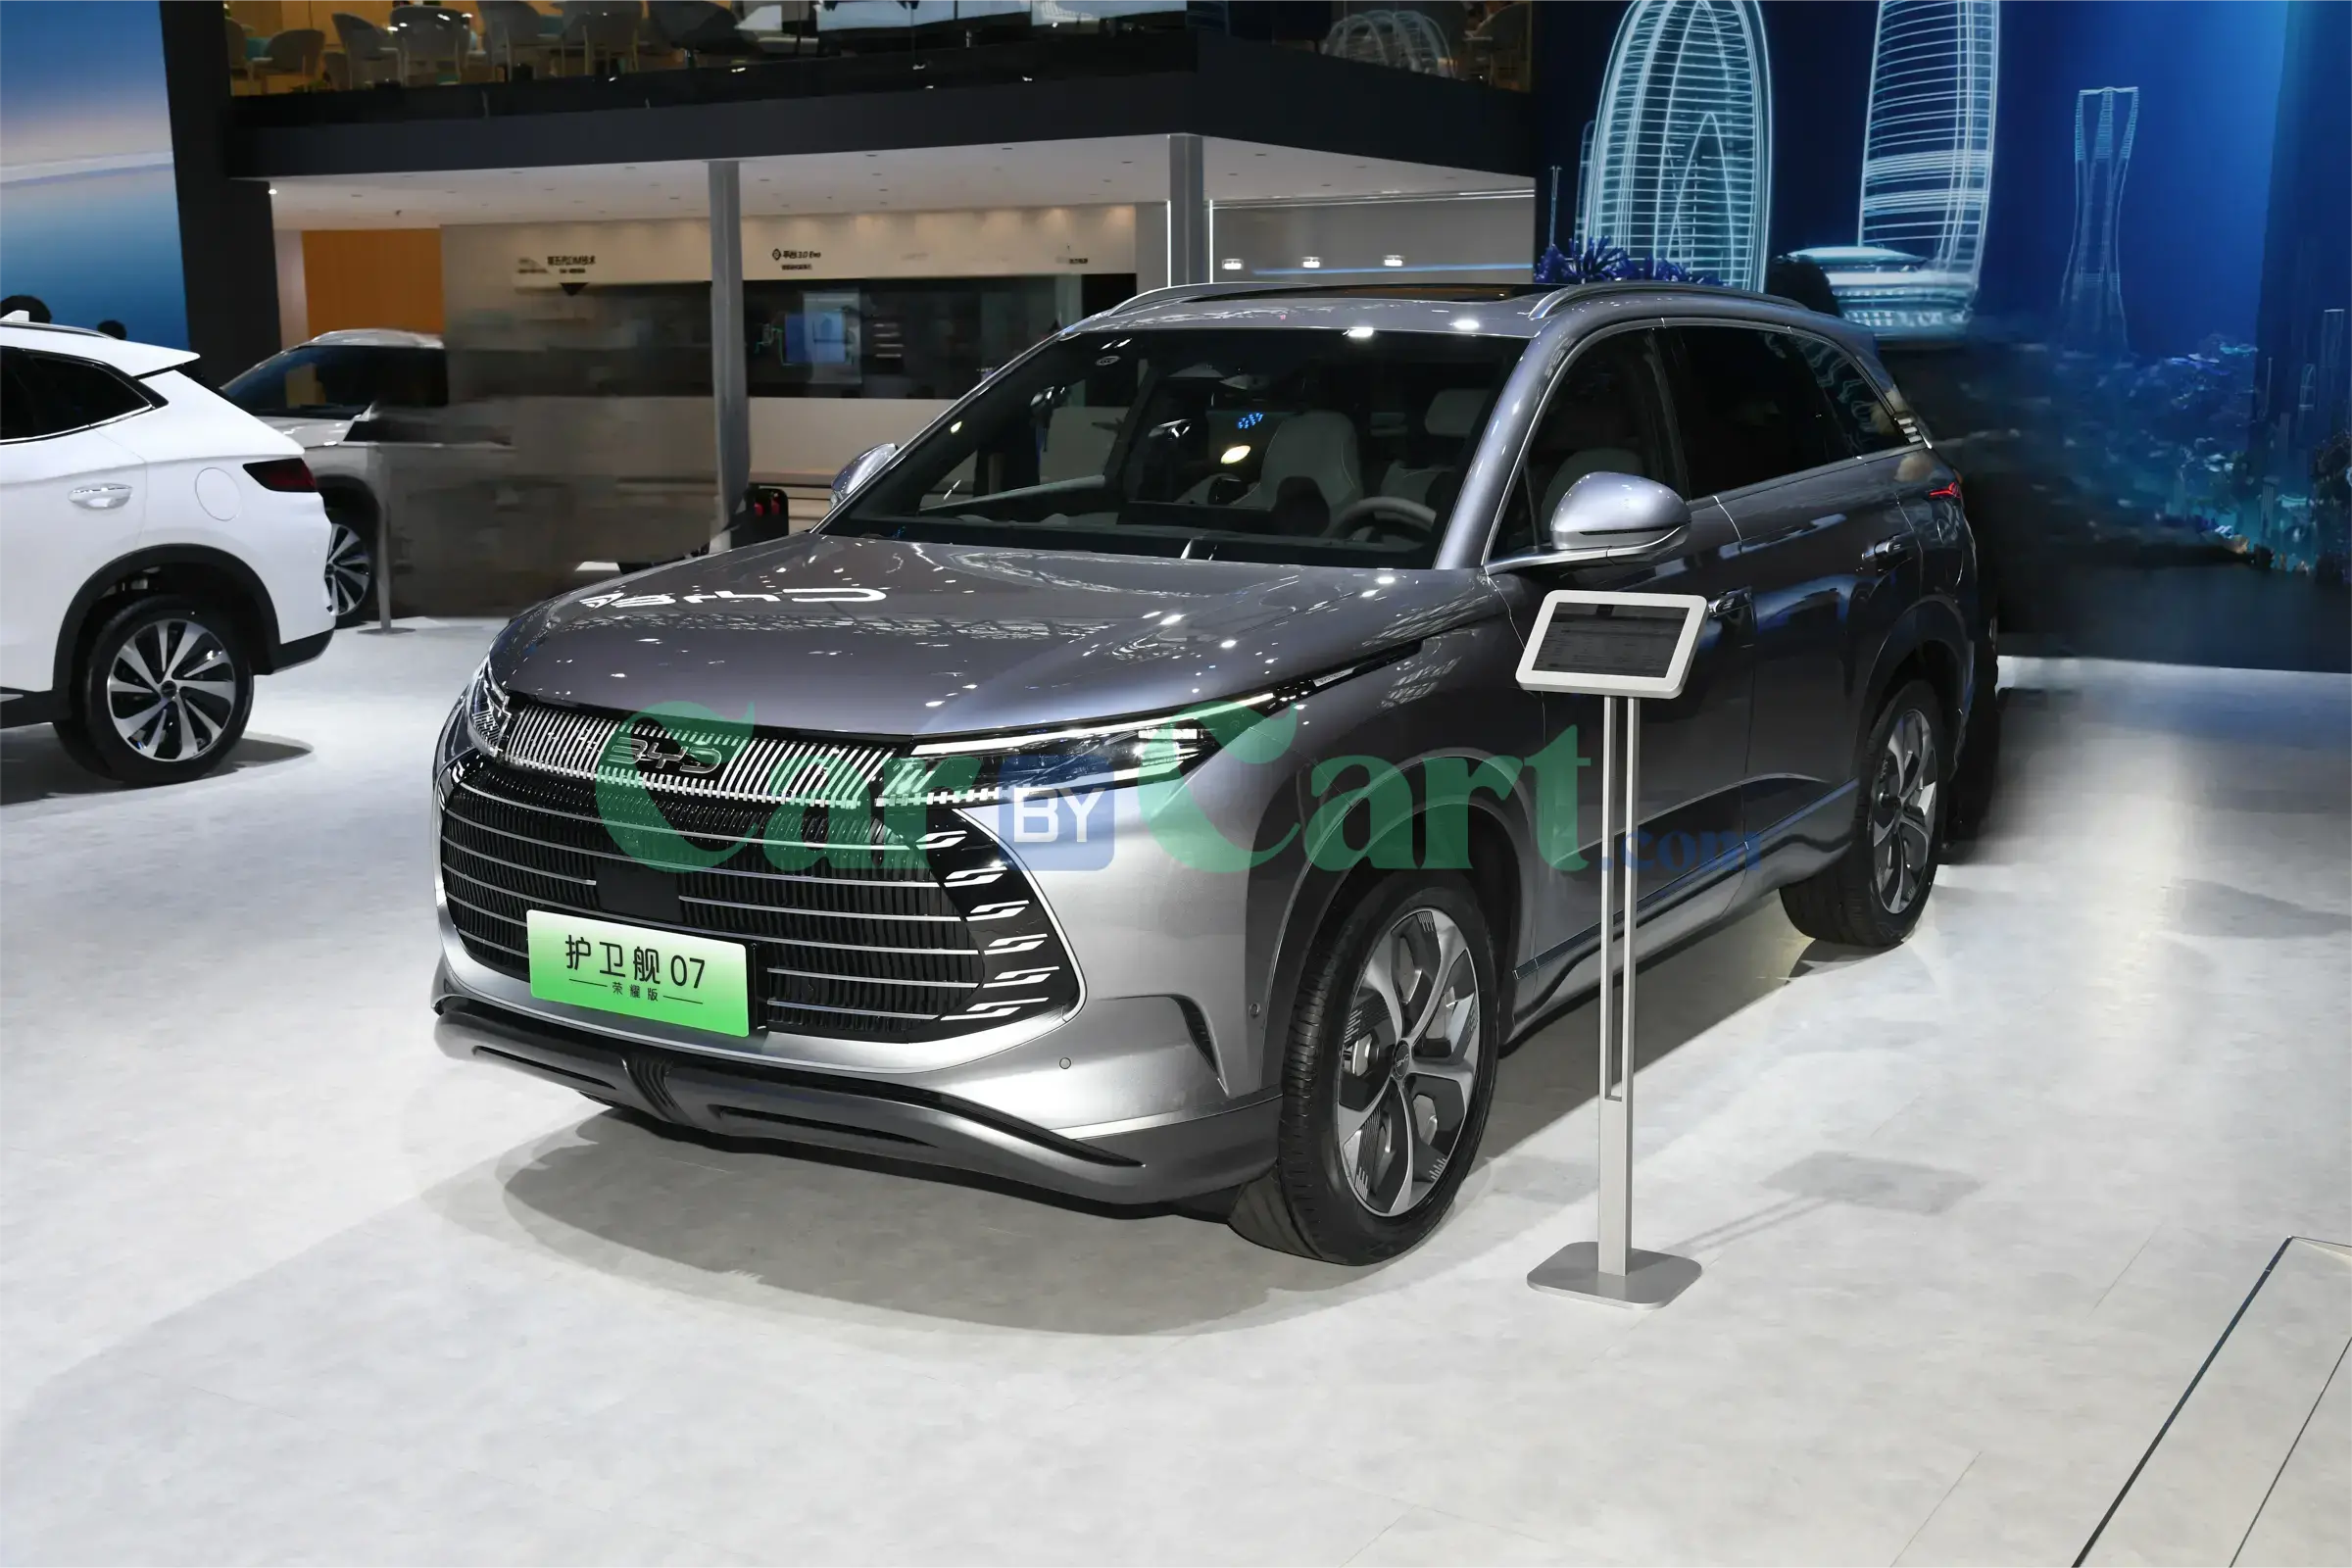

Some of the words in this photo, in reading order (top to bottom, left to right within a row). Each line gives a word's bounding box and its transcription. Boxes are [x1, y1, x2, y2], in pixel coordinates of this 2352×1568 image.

[607, 736, 722, 774] BYD
[612, 981, 659, 1002] 荣耀版
